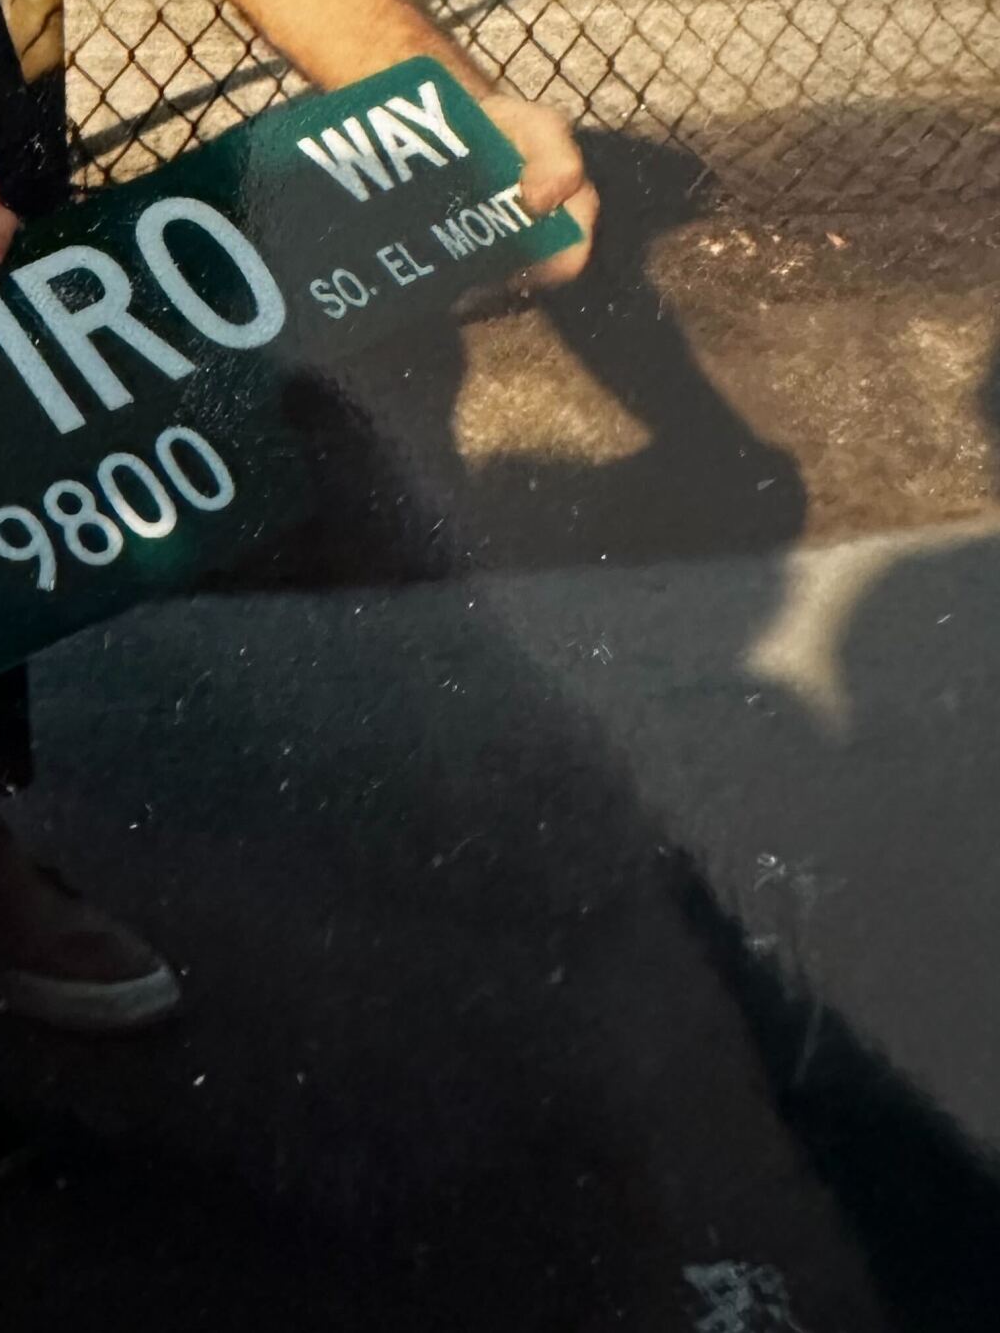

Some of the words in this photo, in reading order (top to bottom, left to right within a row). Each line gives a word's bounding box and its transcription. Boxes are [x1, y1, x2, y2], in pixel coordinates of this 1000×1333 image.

[296, 81, 470, 202] WAY
[309, 268, 378, 320] SO.
[376, 242, 434, 286] EL
[431, 183, 533, 261] MONT
